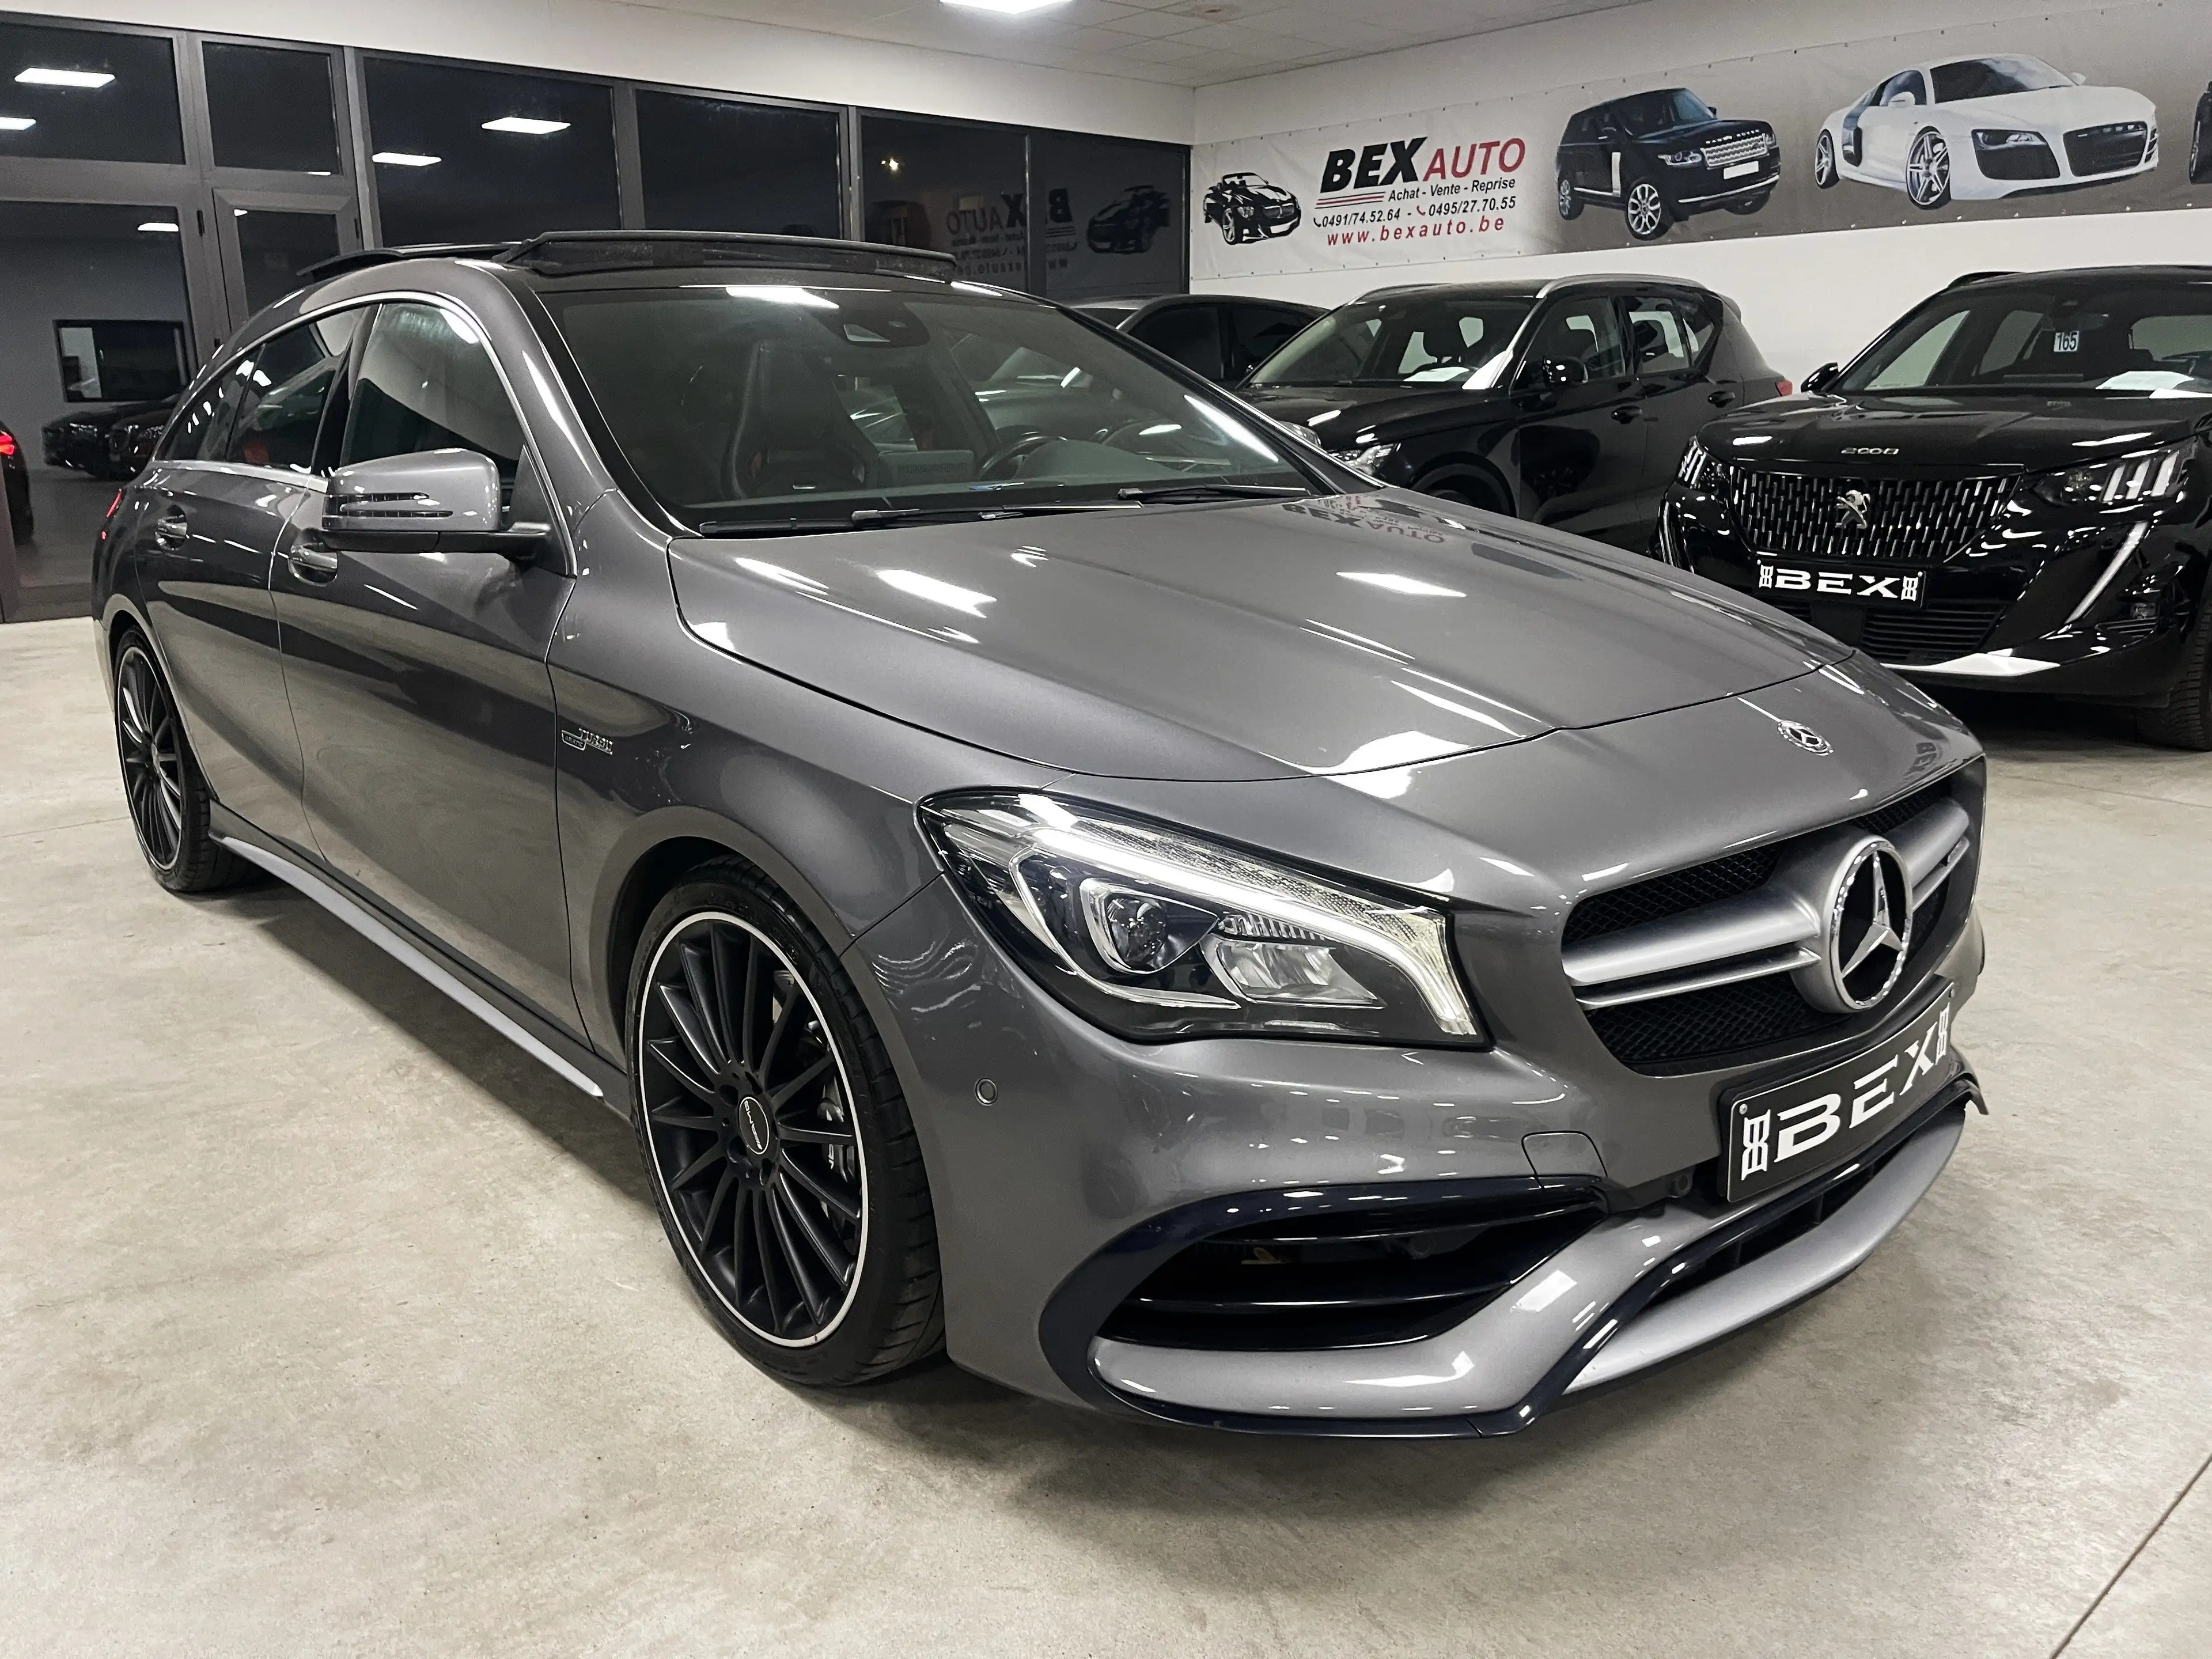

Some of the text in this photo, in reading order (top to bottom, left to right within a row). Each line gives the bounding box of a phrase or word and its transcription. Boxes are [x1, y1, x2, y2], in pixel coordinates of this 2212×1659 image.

[1320, 137, 1525, 193] BEX AUTO
[1388, 187, 1419, 202] Achat
[1430, 184, 1460, 196] Vente
[1471, 177, 1516, 194] Reprise
[1323, 208, 1400, 228] 0491/74.52.64
[1429, 196, 1516, 217] 0495/27.70.55
[1327, 215, 1504, 245] www.bexauto.be
[2057, 331, 2078, 351] 165
[1775, 568, 1900, 599] BEX
[1774, 1021, 1938, 1164] BEX
